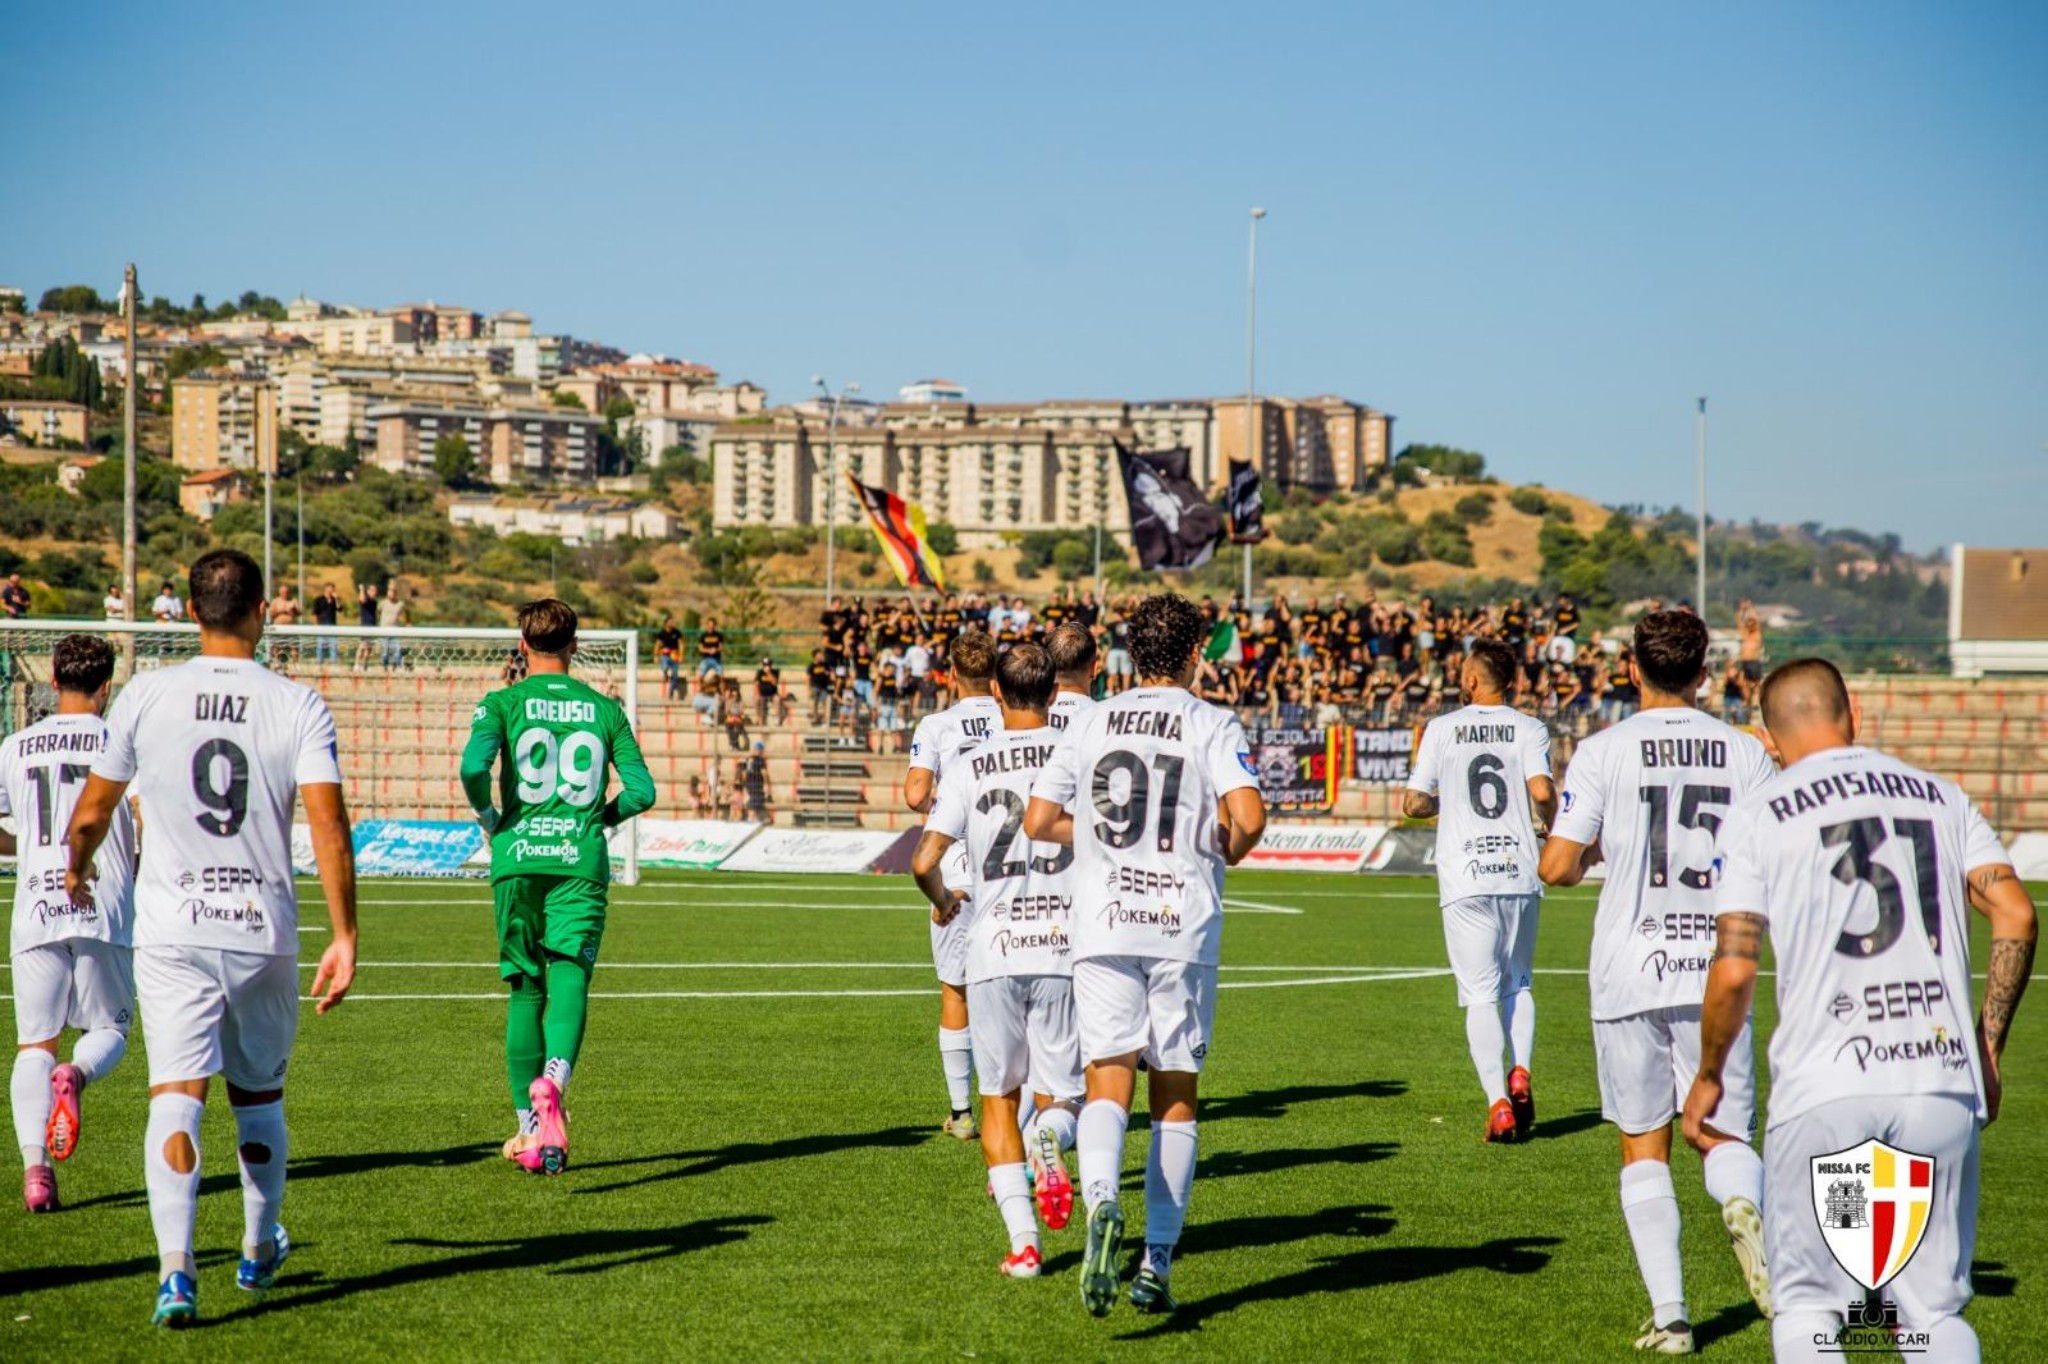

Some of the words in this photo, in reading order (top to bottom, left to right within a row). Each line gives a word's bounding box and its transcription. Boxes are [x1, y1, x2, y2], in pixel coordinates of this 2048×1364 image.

[196, 694, 250, 723] DIAZ
[525, 698, 595, 723] CREUSO
[1107, 711, 1183, 741] MEGNA
[1455, 725, 1515, 744] MARINO
[1640, 738, 1727, 769] BRUNO
[515, 727, 604, 807] 99
[972, 744, 1055, 780] PALERM
[1357, 757, 1409, 779] VIVE
[192, 738, 249, 838] 9
[1091, 750, 1184, 853] 91
[1468, 753, 1508, 820] 6
[1769, 771, 1946, 824] RAPISARDA
[1820, 816, 1943, 959] 31
[1864, 980, 1948, 1022] SERP
